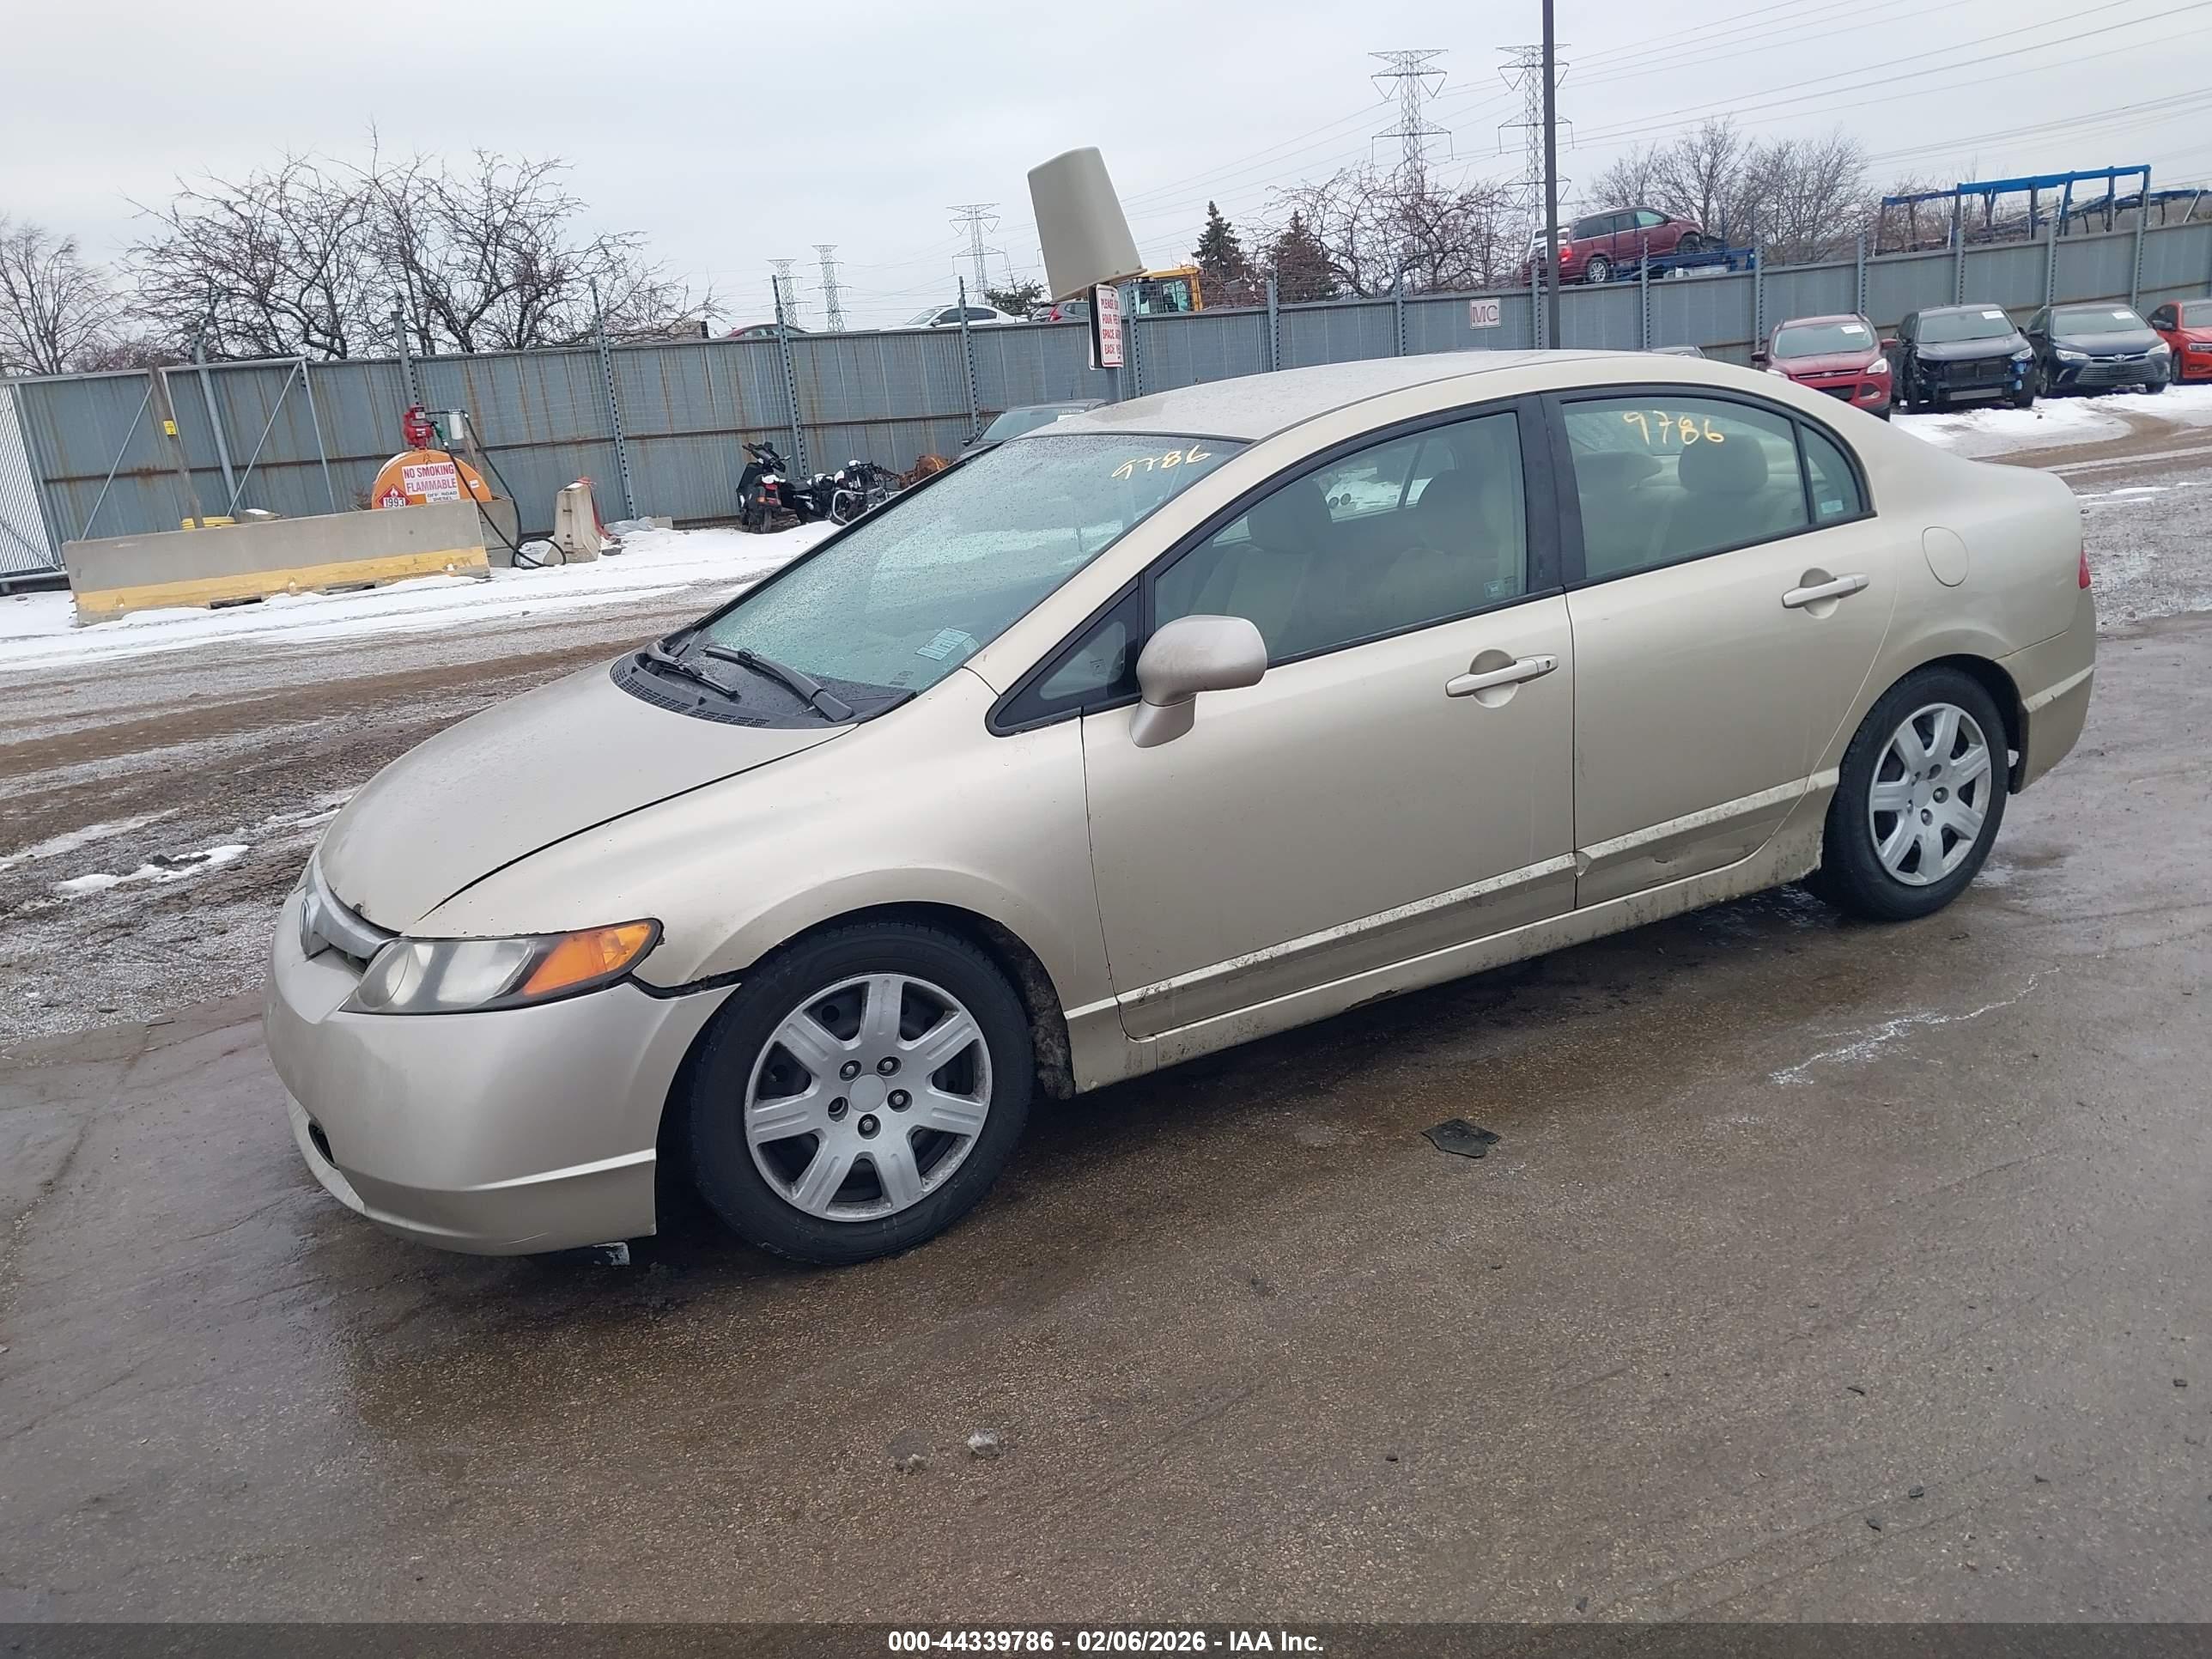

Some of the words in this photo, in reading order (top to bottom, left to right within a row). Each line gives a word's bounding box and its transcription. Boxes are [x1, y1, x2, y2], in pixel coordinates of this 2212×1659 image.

[1472, 305, 1498, 323] MC
[1623, 410, 1724, 446] 9786
[1110, 444, 1212, 480] 9786
[404, 468, 415, 479] NO
[417, 464, 454, 477] SMOKING
[406, 478, 457, 492] FLAMMABLE
[385, 498, 404, 507] 1993
